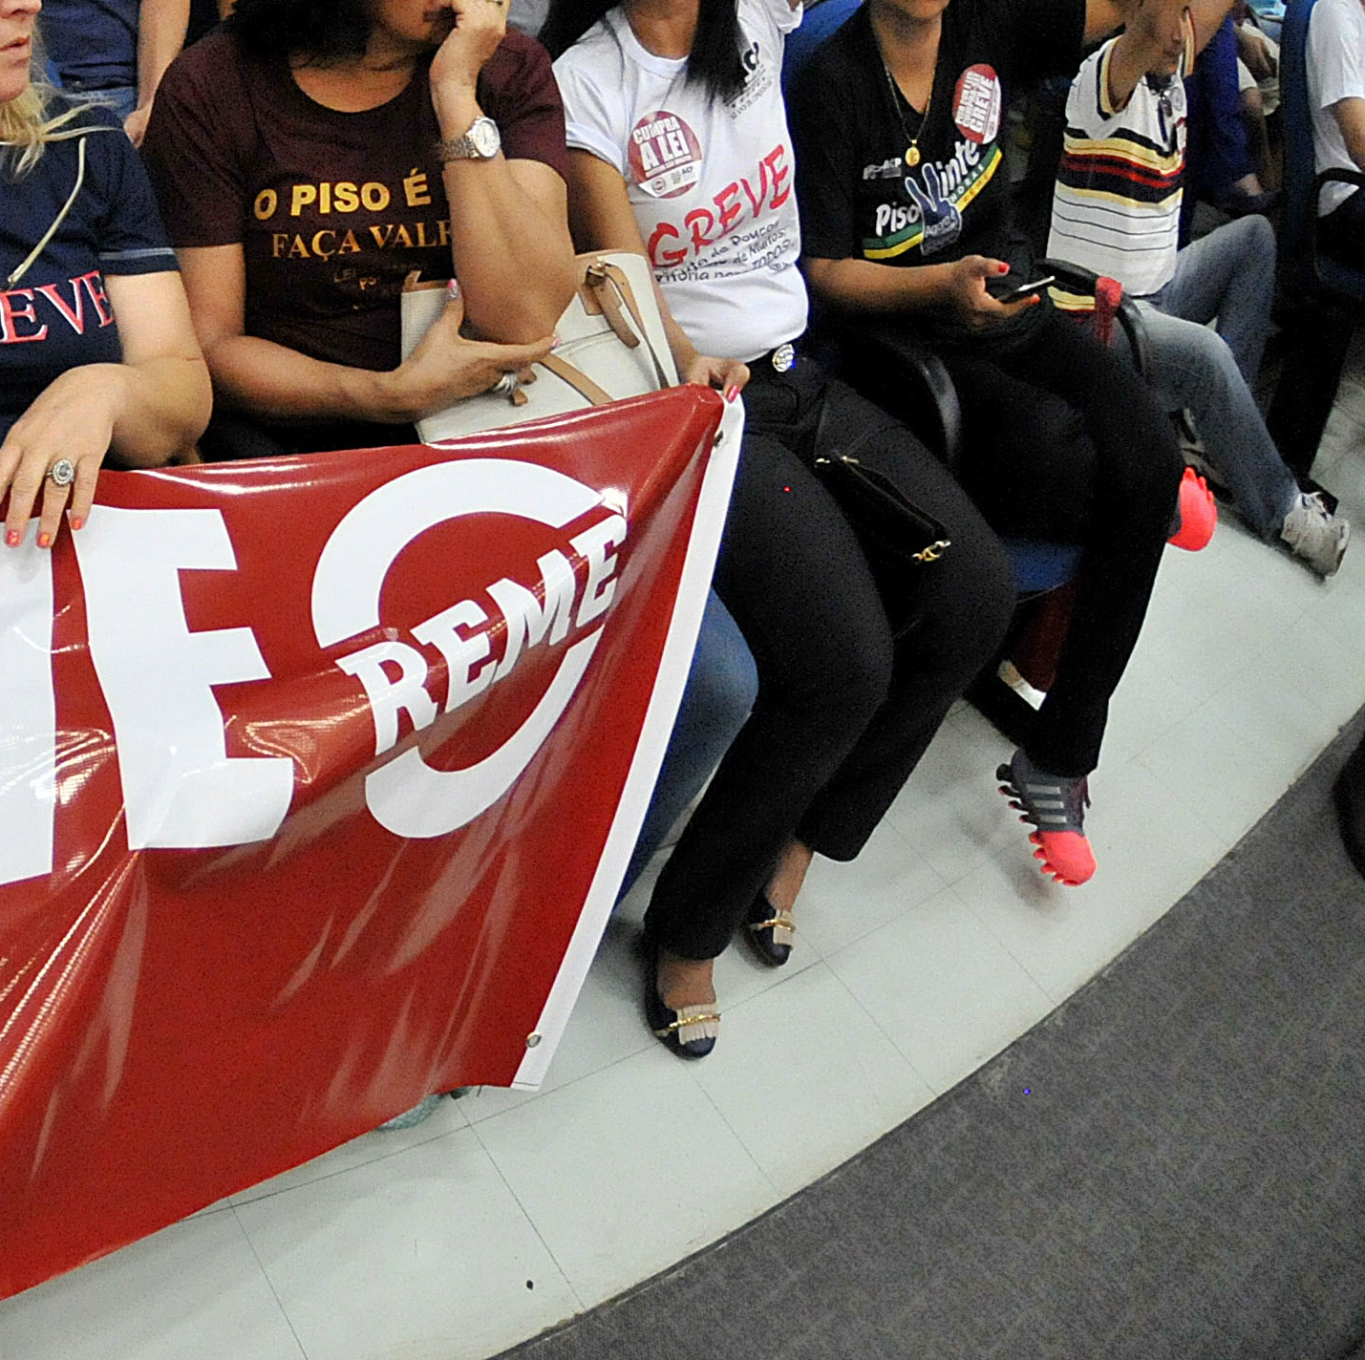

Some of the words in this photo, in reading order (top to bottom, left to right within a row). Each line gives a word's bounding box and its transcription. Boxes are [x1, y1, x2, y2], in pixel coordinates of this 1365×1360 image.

[633, 116, 681, 144] CUMPRA
[640, 144, 660, 172] A
[657, 130, 690, 164] LEI
[254, 188, 277, 220] O
[290, 181, 390, 217] PISO
[403, 168, 432, 207] É
[647, 144, 791, 268] GREVE
[876, 202, 921, 237] Piso
[272, 228, 362, 262] FAÇA
[335, 513, 628, 757] REME
